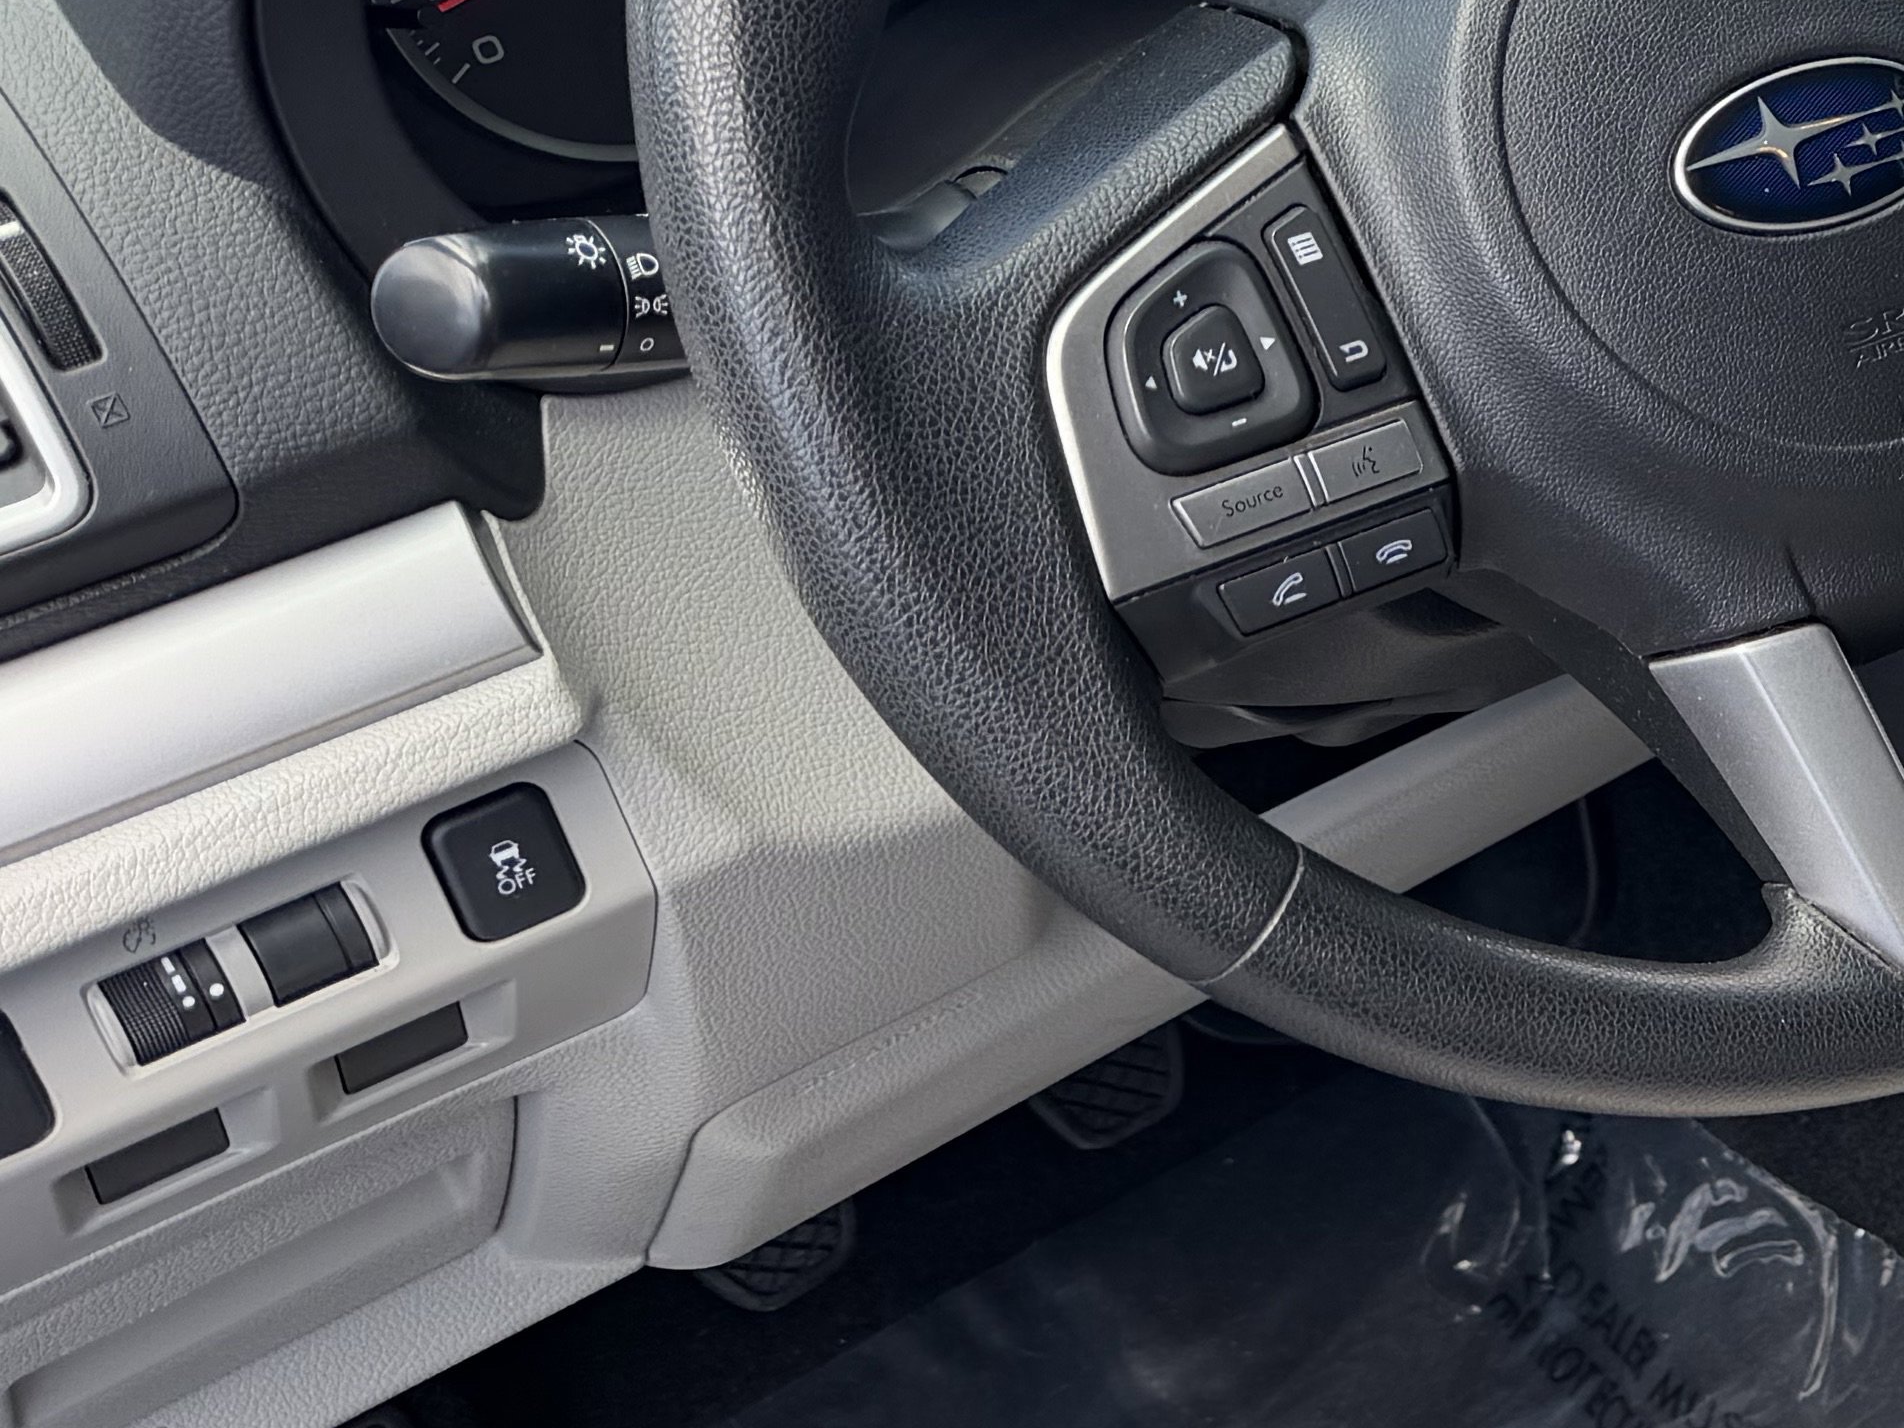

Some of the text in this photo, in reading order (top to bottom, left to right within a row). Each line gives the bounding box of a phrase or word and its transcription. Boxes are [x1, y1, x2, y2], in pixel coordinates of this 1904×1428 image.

[472, 34, 504, 65] 0
[1221, 481, 1284, 518] Source
[498, 867, 537, 896] OFF
